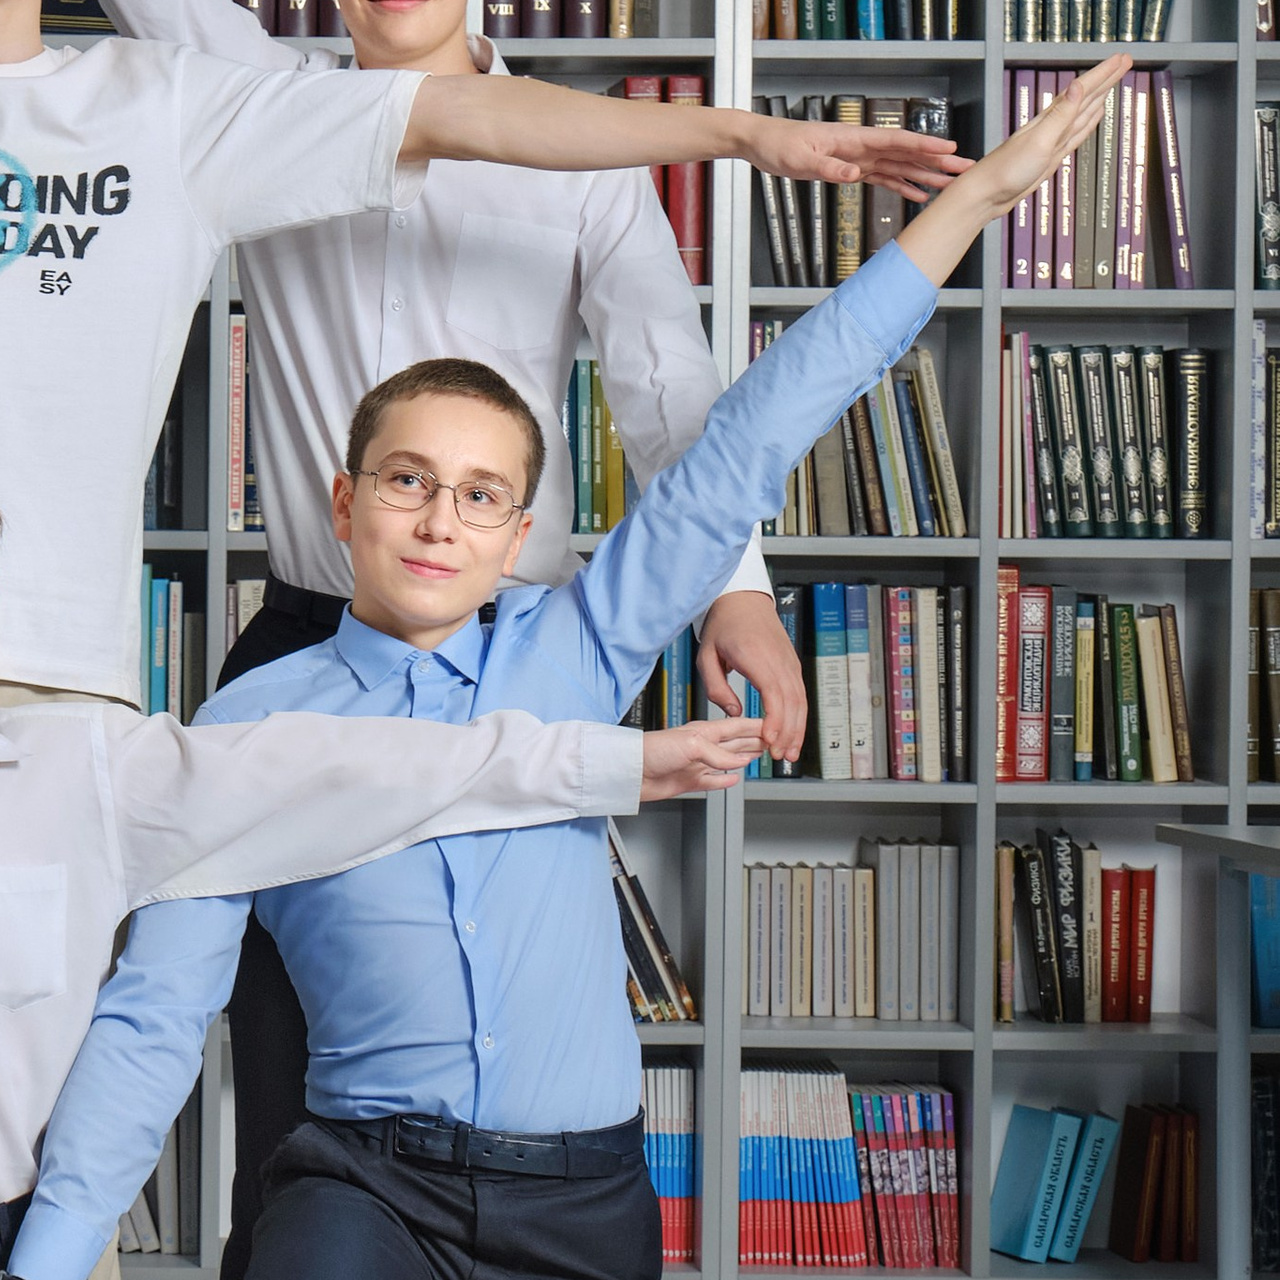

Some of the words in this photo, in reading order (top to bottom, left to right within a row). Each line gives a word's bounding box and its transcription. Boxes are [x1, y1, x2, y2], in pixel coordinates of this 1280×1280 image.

[488, 3, 514, 16] VIII
[533, 0, 550, 12] IX
[578, 2, 592, 15] X
[38, 283, 71, 296] SY
[40, 270, 72, 283] EA
[1016, 258, 1028, 275] 2
[1037, 261, 1051, 279] 3
[1060, 261, 1073, 279] 4
[1097, 259, 1109, 276] 6
[232, 332, 242, 392] ГИННЕССА
[232, 397, 241, 459] РЕКОРДОВ
[1186, 375, 1201, 489] ЭНЦИКЛОПЕДИЯ
[232, 463, 240, 502] КНИГА
[1055, 605, 1064, 677] МАТЕМАТИЧЕСКАЯ
[1063, 605, 1073, 677] ЭНЦИКЛОПЕДИЯ
[1023, 639, 1033, 712] ЛЕРМОНТОВСКАЯ
[1032, 639, 1043, 712] ЭНЦИКЛОПЕДИЯ
[1121, 644, 1134, 702] PARADOX
[1052, 837, 1074, 906] ФИЗИКИ
[1062, 914, 1078, 948] МИР
[1033, 1184, 1057, 1249] САМАРСКАЯ
[1048, 1135, 1069, 1183] ОБЛАСТЬ
[1064, 1184, 1091, 1249] САМАРСКАЯ
[1084, 1137, 1105, 1183] ОБЛАСТЬ
